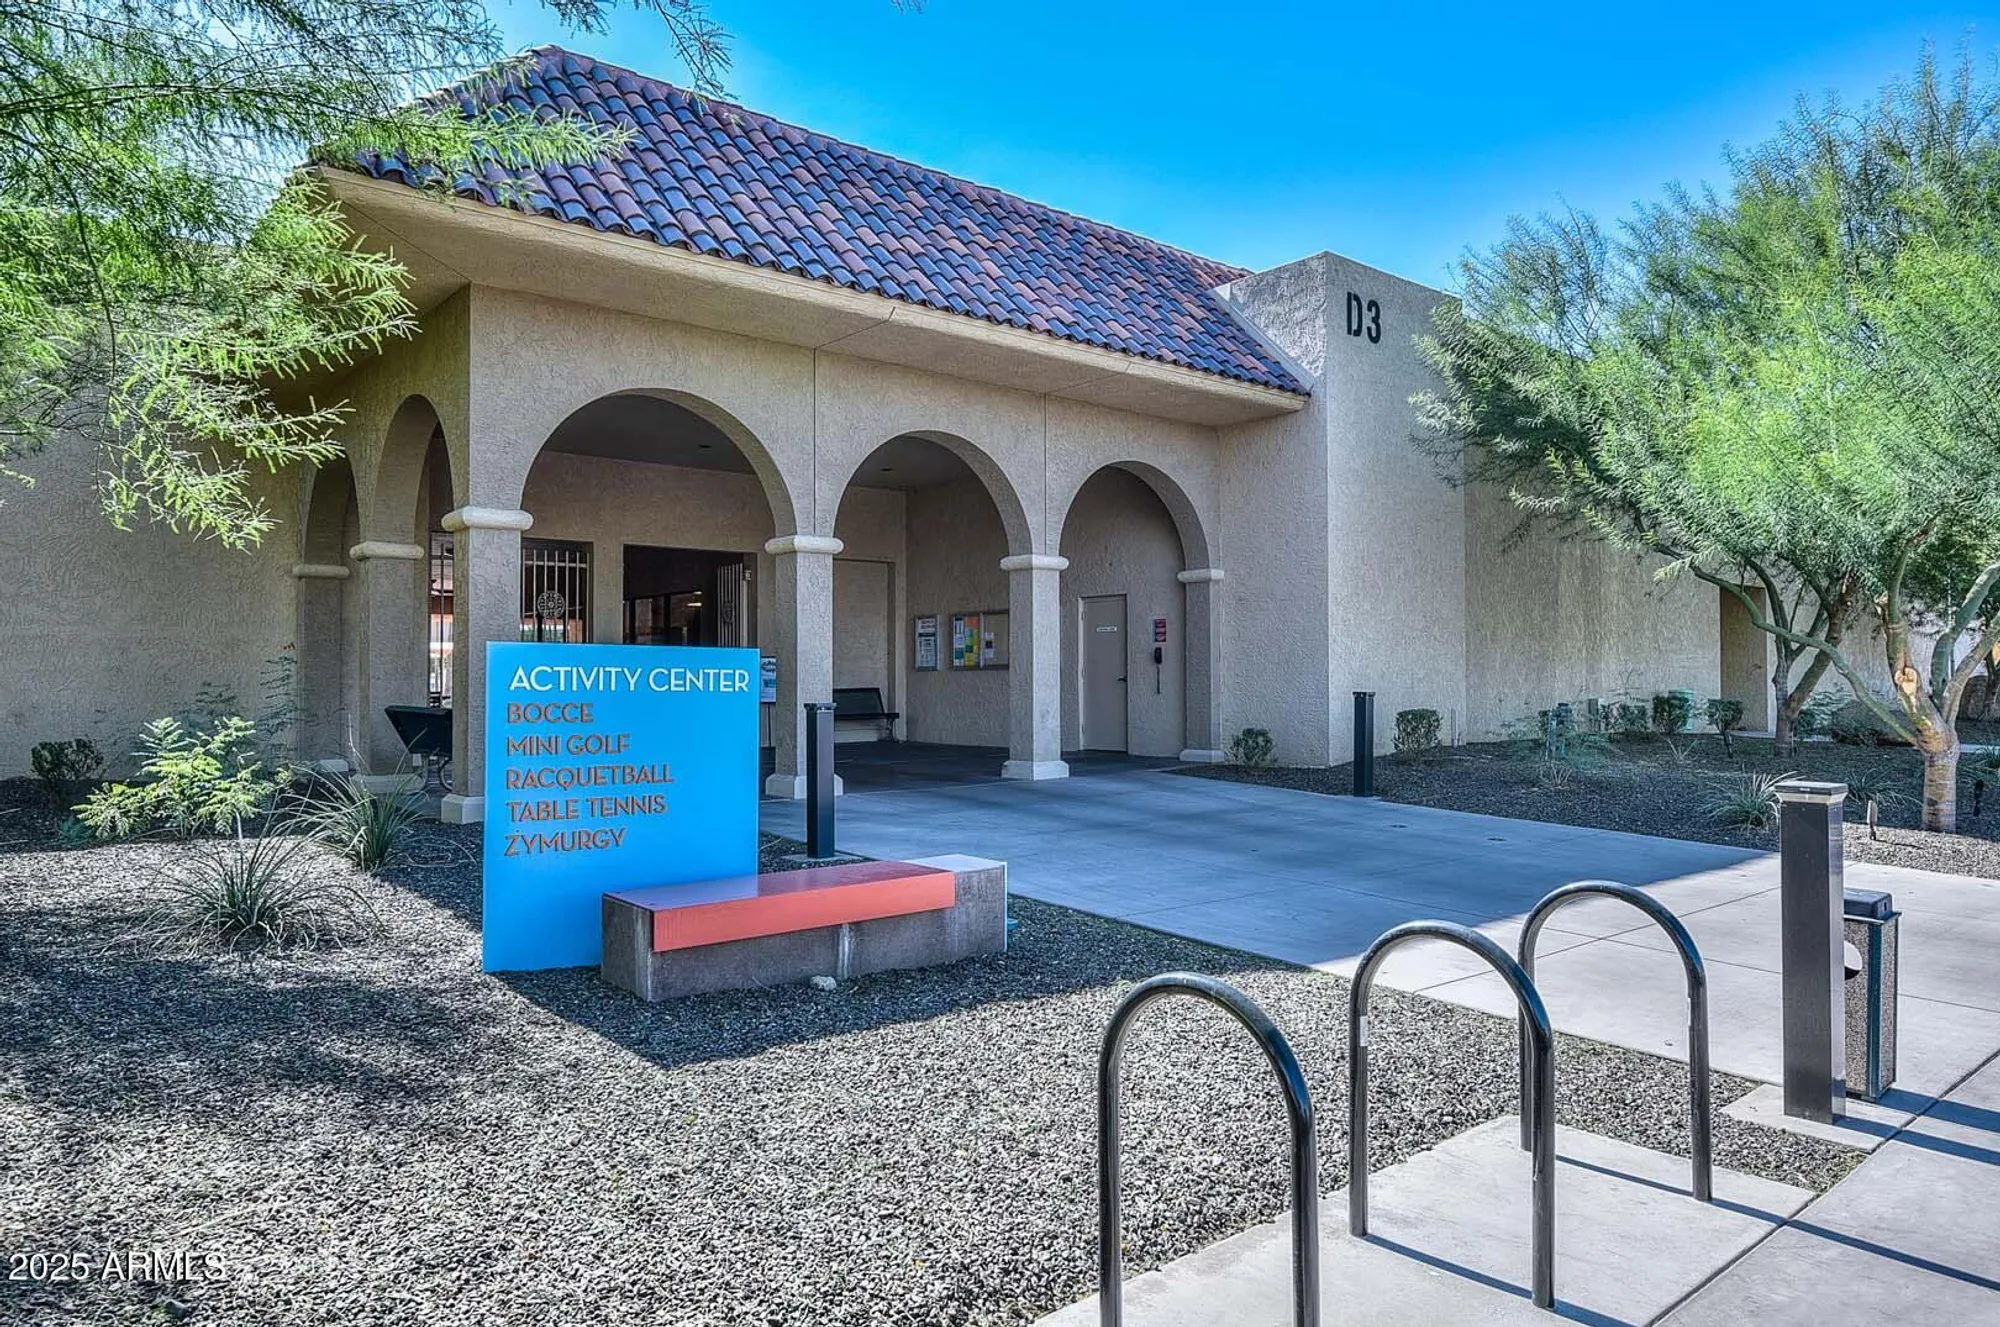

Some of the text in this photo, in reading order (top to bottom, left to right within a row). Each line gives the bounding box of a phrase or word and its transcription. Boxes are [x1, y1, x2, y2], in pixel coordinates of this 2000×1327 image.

[1346, 291, 1381, 344] D3
[509, 665, 750, 692] ACTIVITY CENTER
[506, 702, 594, 724] BOCCE
[506, 733, 631, 757] MINI GOLF
[505, 763, 675, 791] RACQUETBALL
[505, 794, 668, 822] TABLE TENNIS
[504, 827, 626, 857] ZYMURGY
